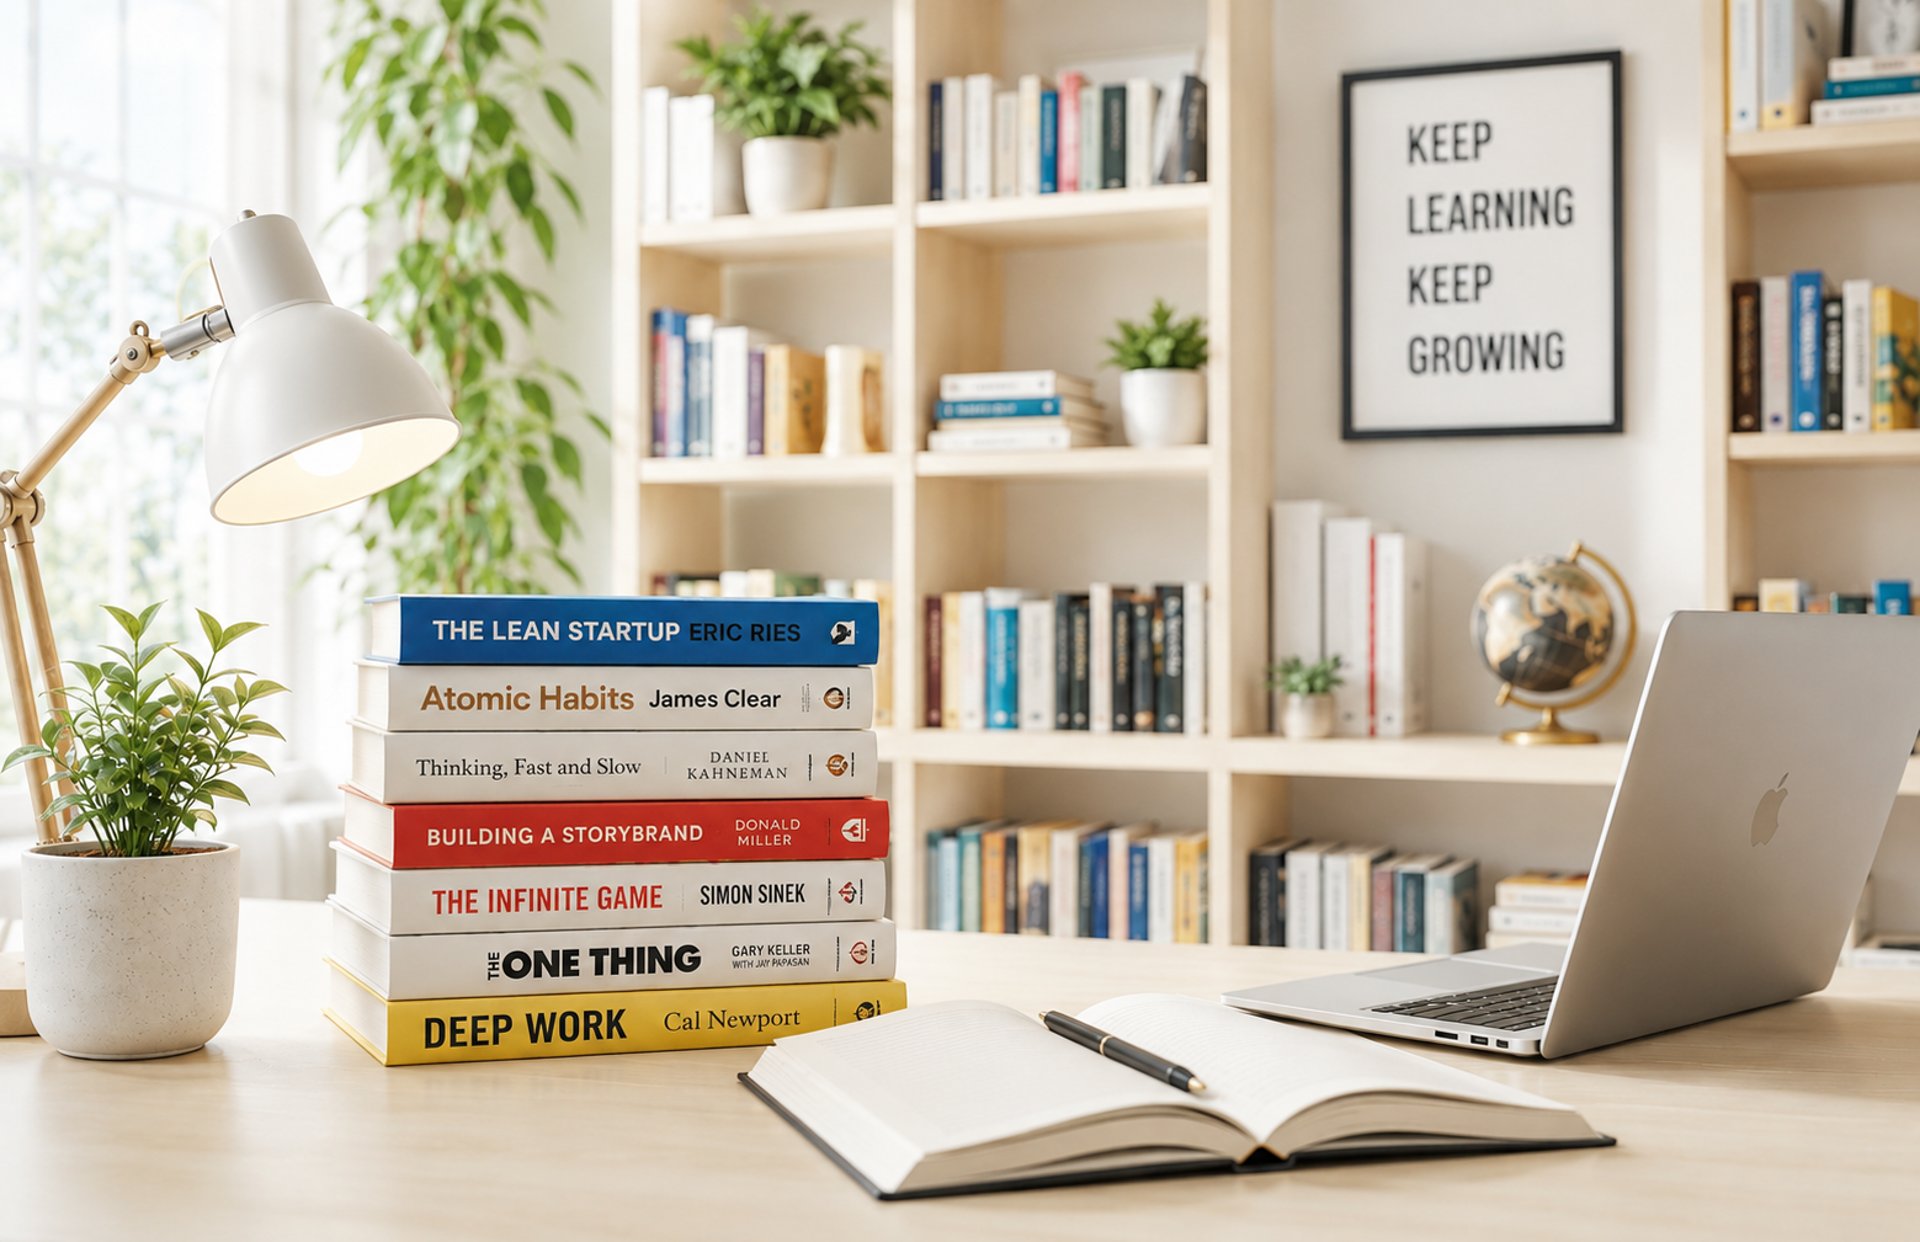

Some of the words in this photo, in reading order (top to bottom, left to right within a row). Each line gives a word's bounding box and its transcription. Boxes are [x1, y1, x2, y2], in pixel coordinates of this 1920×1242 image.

[1408, 121, 1492, 164] KEEP
[1409, 187, 1573, 234] LEARNING
[1409, 264, 1492, 304] KEEP
[1409, 331, 1563, 375] GROWING
[433, 621, 483, 640] THE
[493, 621, 559, 640] LEAN
[569, 622, 680, 641] STARTUP
[690, 623, 742, 641] ERIC
[751, 624, 800, 641] RIES
[421, 685, 530, 710] Atomic
[540, 685, 634, 710] Habits
[649, 690, 718, 707] James
[725, 689, 781, 707] Clear
[711, 752, 768, 763] DANIEL
[416, 759, 507, 780] Thinking,
[515, 759, 551, 775] Fast
[558, 758, 591, 774] and
[597, 758, 641, 774] Slow
[688, 768, 787, 779] KAHNEMAN
[428, 828, 533, 846] BUILDING
[541, 828, 555, 843] A
[563, 825, 702, 842] STORYBRAND
[736, 819, 800, 831] DONALD
[738, 834, 791, 846] MILLER
[432, 890, 478, 914] THE
[489, 887, 588, 913] INFINITE
[598, 885, 662, 910] GAME
[701, 885, 752, 905] SIMON
[759, 884, 805, 903] SINEK
[732, 945, 764, 957] GARY
[768, 944, 810, 955] KELLER
[488, 953, 499, 980] THE
[502, 949, 579, 979] ONE
[589, 945, 701, 976] THING
[732, 960, 754, 969] WITH
[755, 959, 770, 968] JAY
[425, 1015, 512, 1049] DEEP
[526, 1009, 627, 1043] WORK
[664, 1011, 700, 1031] Cal
[707, 1010, 800, 1033] Newport
